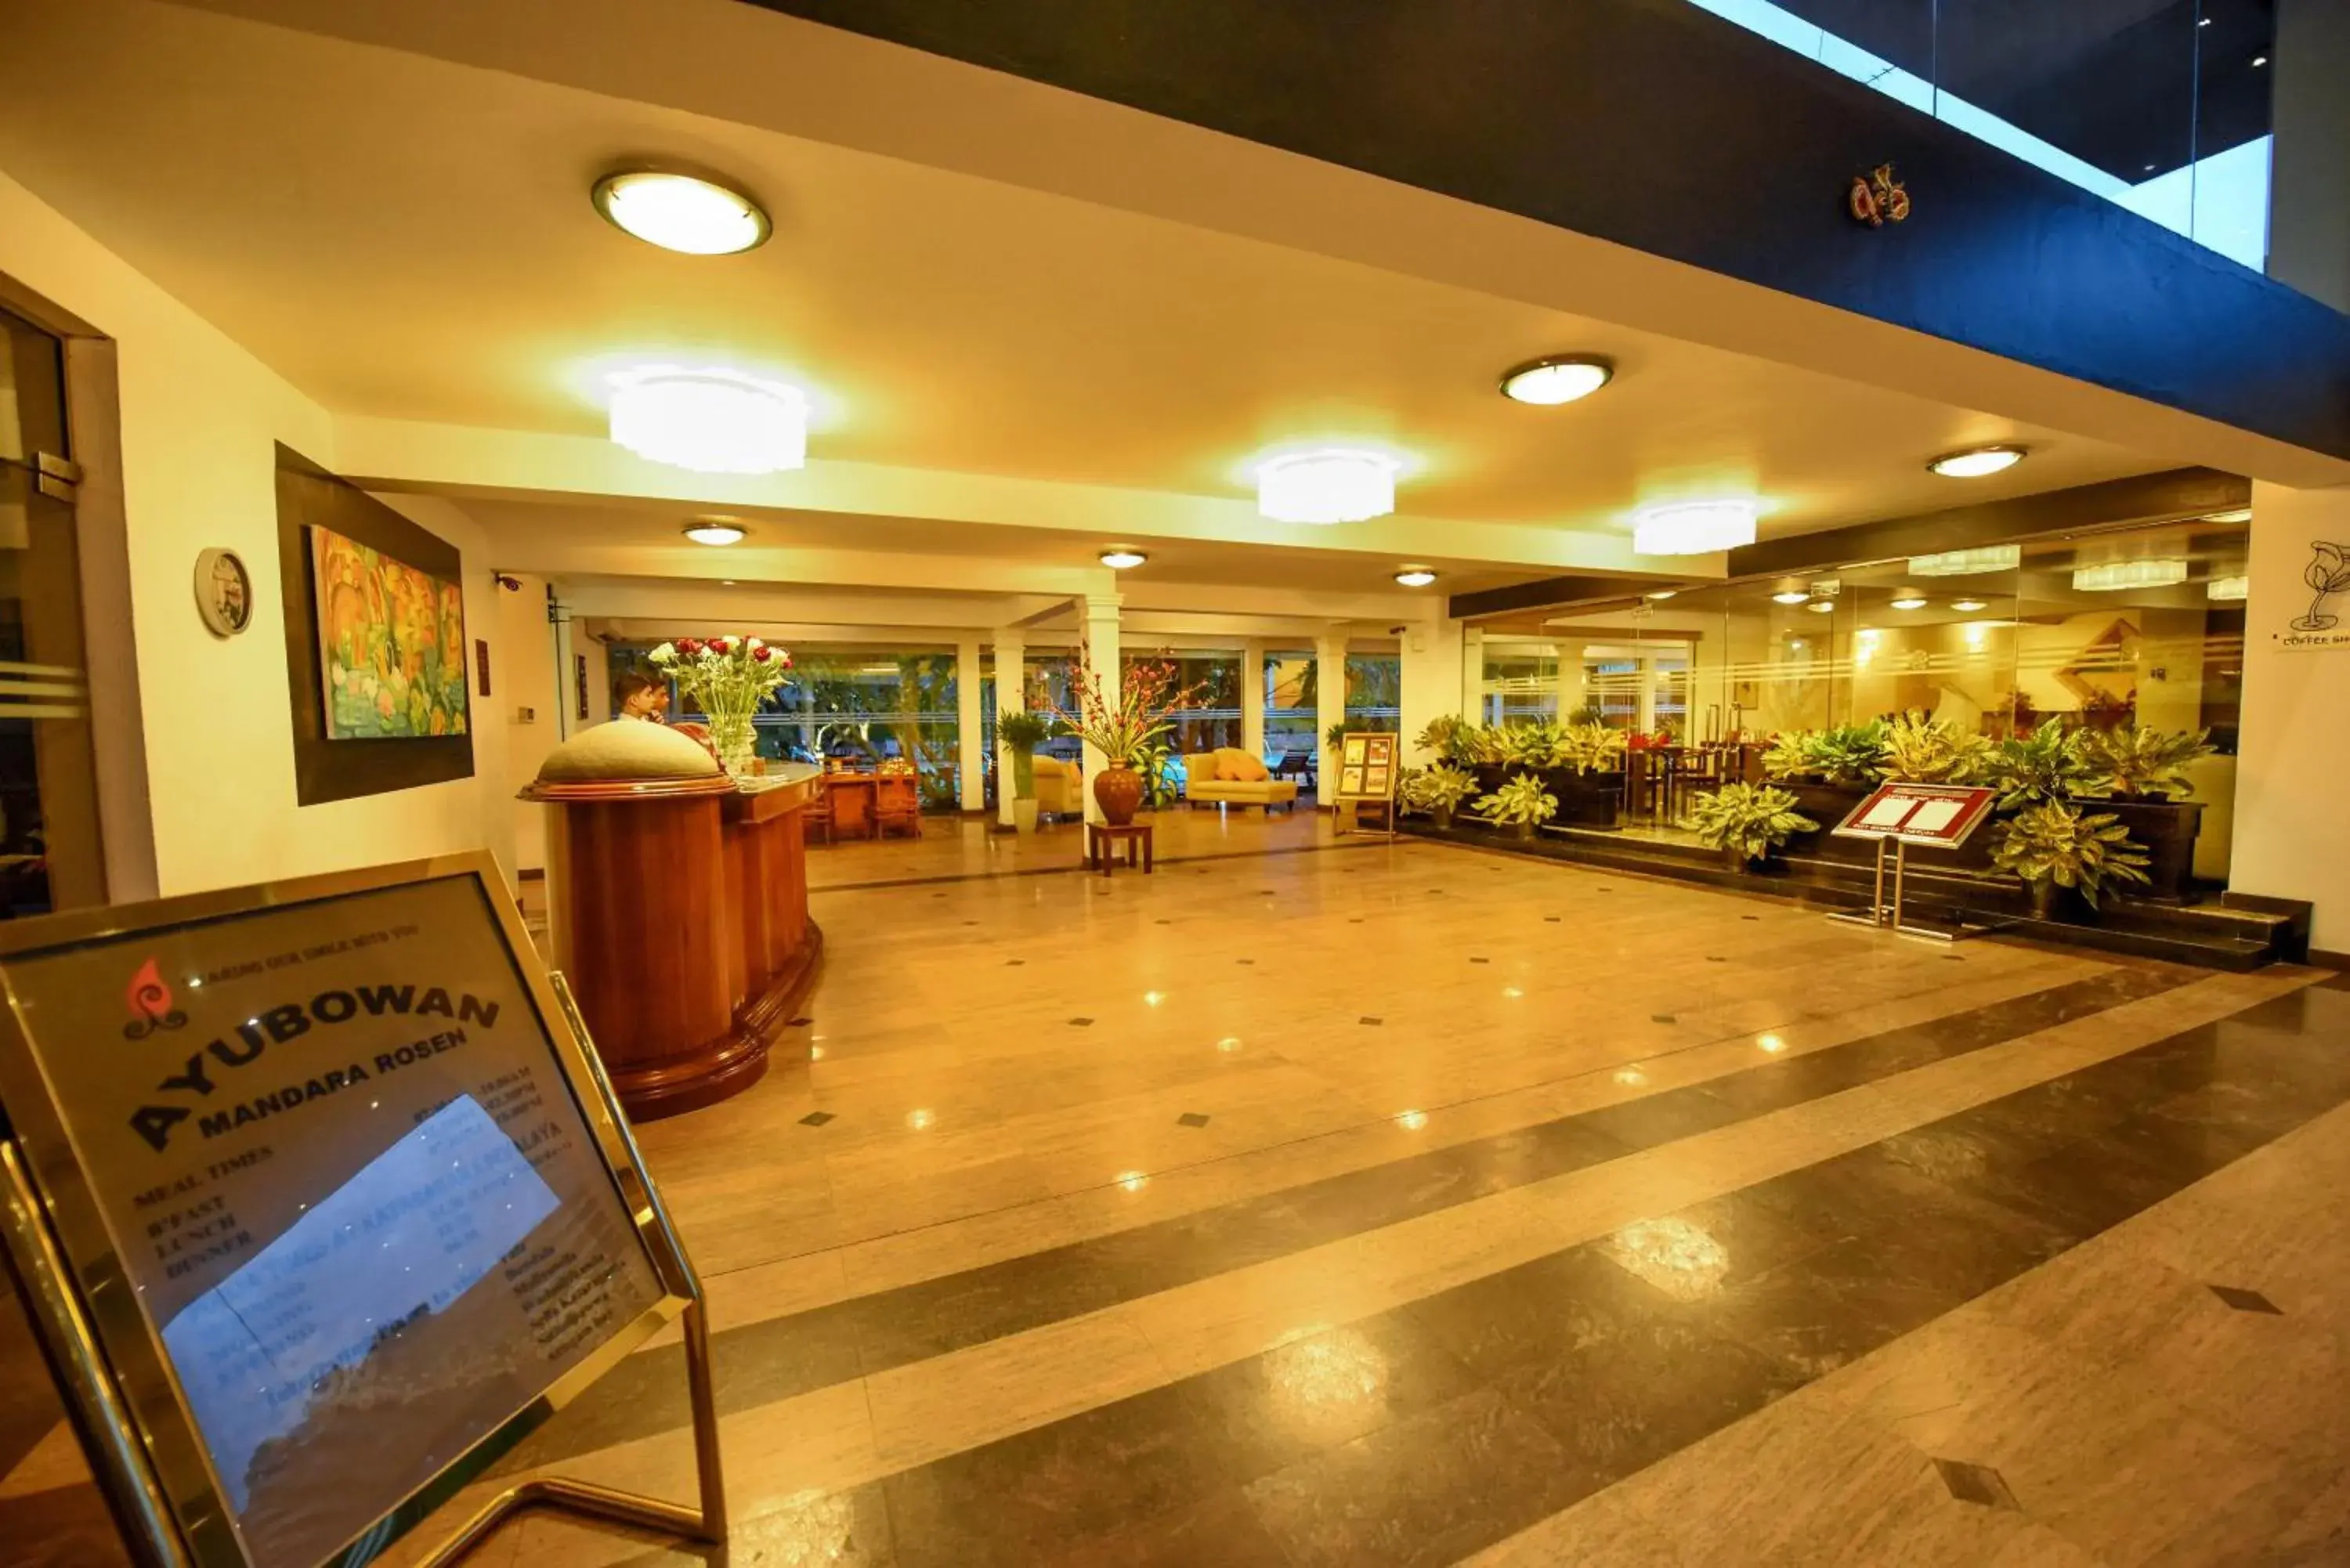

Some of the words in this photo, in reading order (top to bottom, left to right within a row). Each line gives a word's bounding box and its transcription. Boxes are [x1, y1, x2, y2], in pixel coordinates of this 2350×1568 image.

[128, 984, 501, 1154] AYUBOWAN
[197, 1063, 371, 1140] MANDARA
[373, 1027, 468, 1075] ROSEN
[132, 1174, 203, 1210] MEAL
[204, 1144, 273, 1180] TIMES
[154, 1212, 237, 1260] LUNCH
[164, 1228, 254, 1281] DINNER
